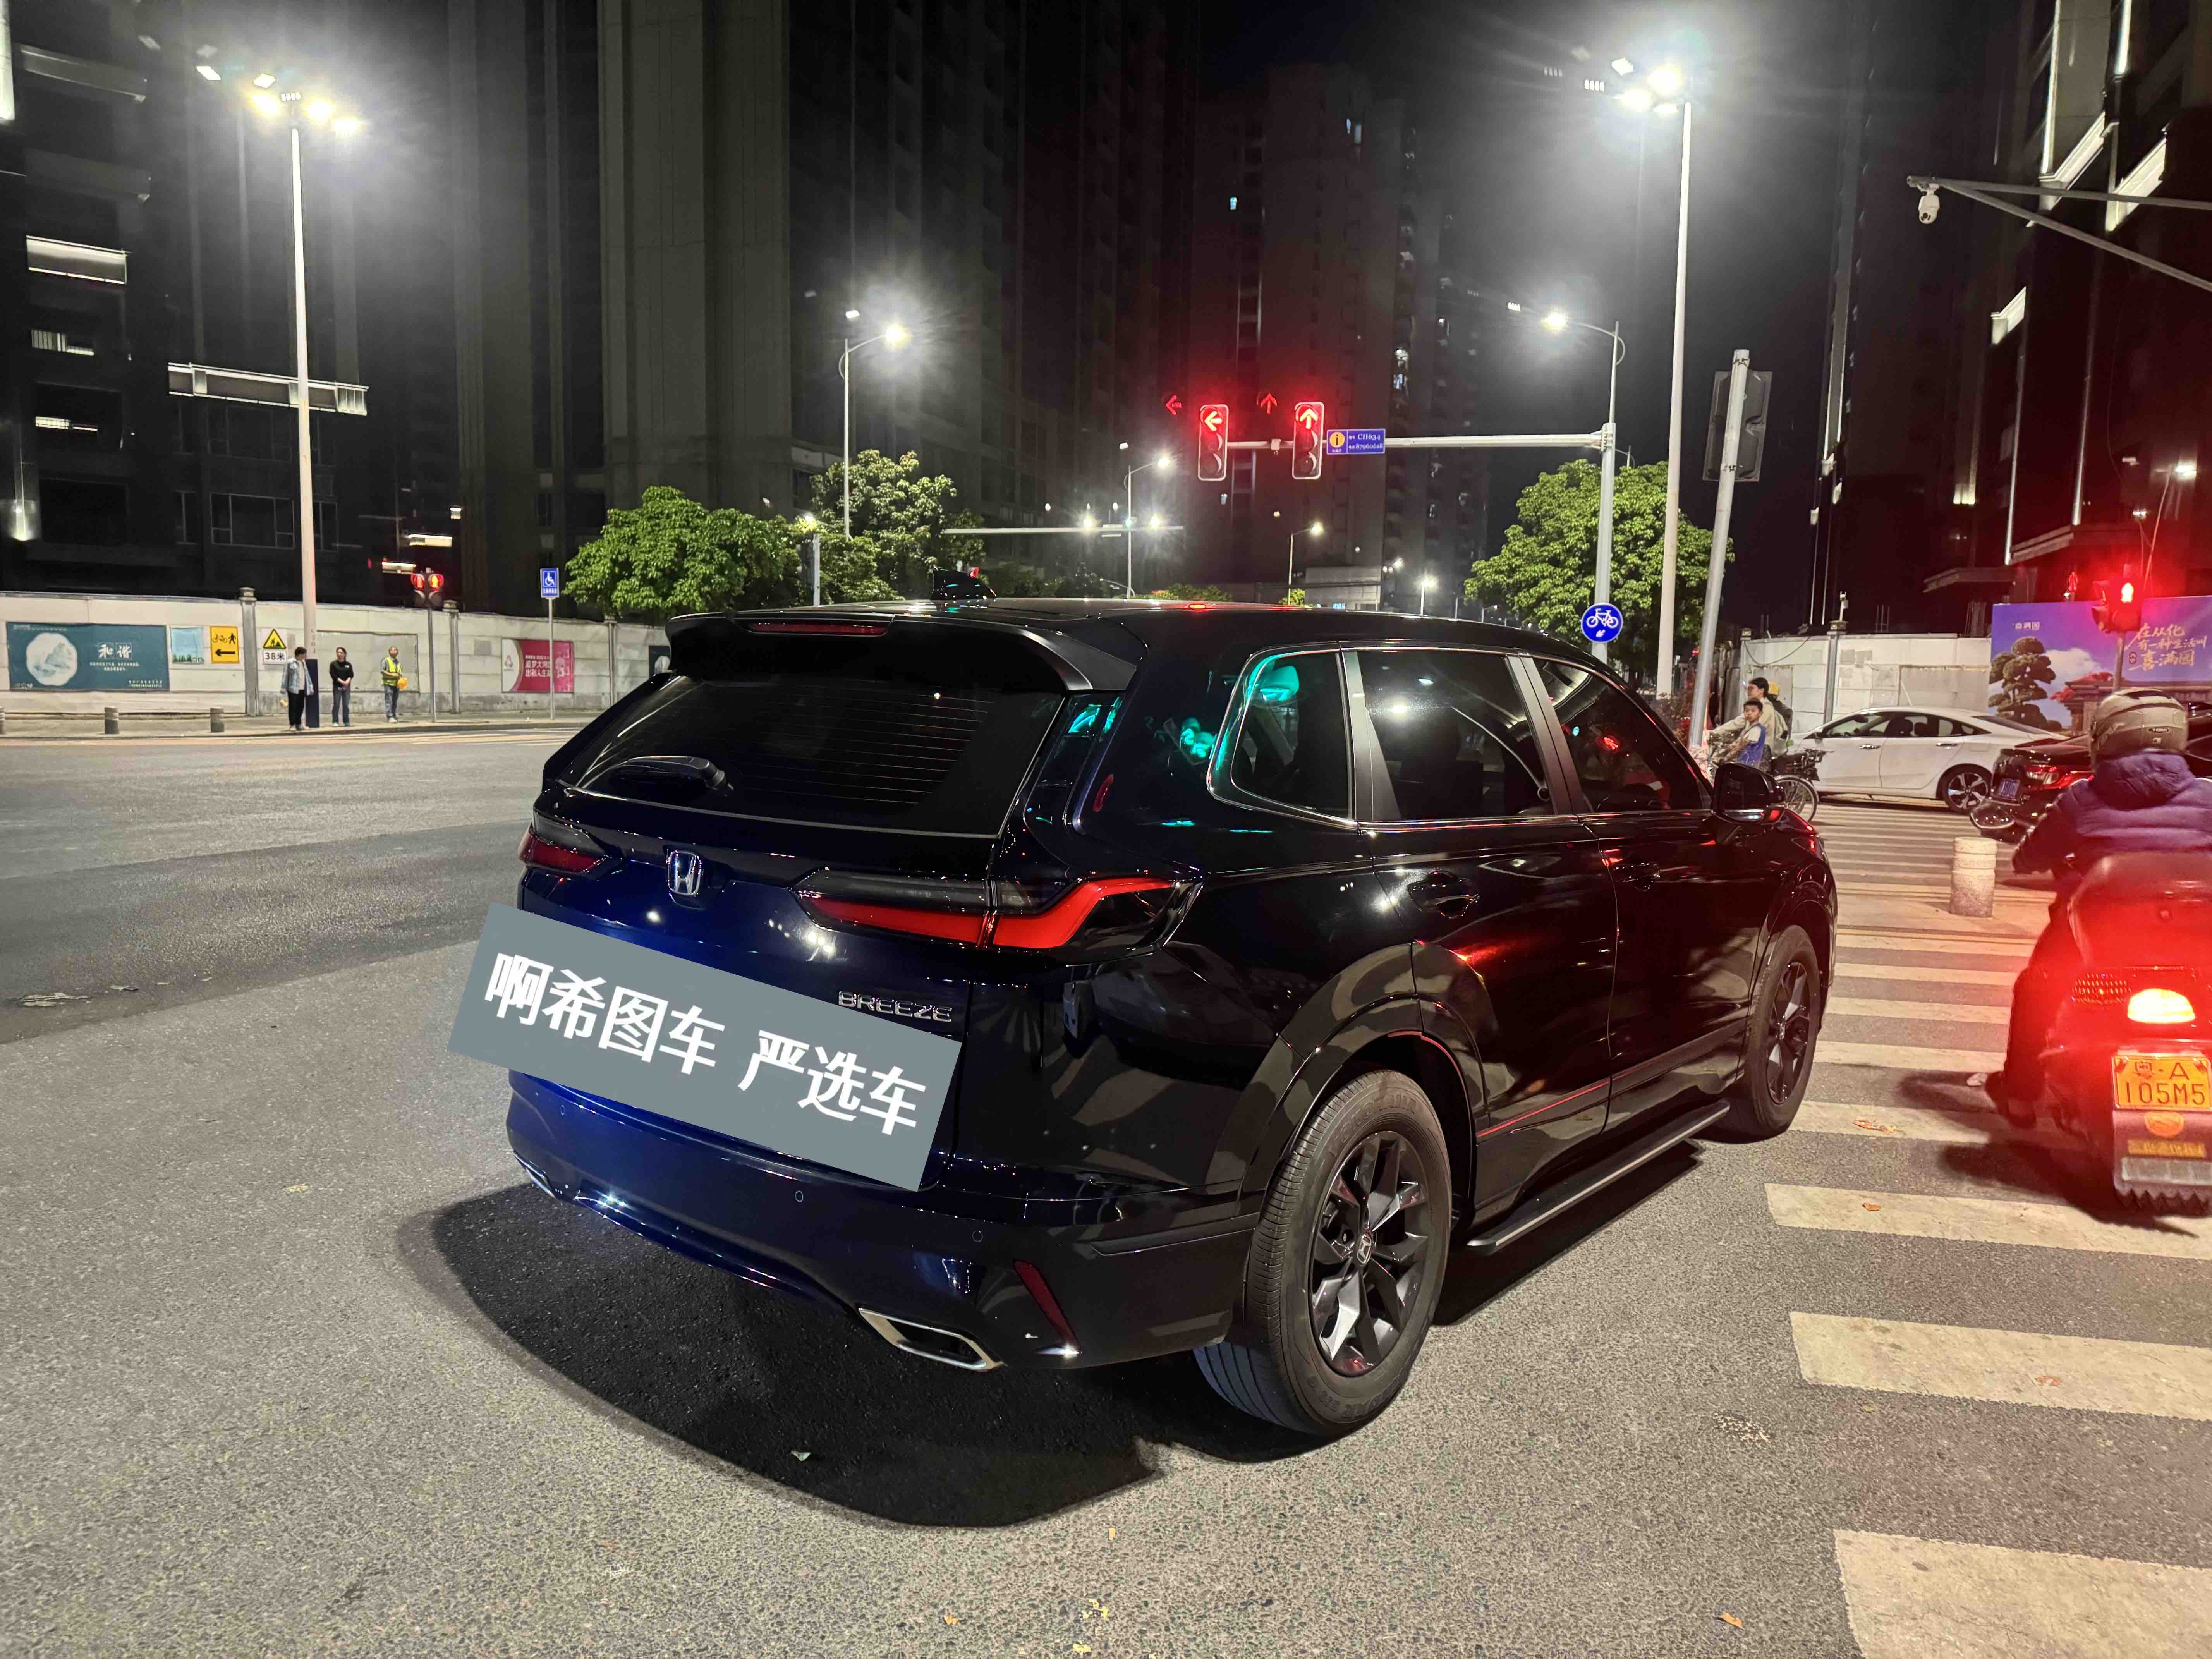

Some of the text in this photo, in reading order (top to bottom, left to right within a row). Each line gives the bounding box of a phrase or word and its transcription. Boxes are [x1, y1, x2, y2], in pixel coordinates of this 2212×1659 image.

[98, 644, 132, 659] 和谐
[838, 991, 953, 1023] BREEZE
[2126, 1082, 2205, 1105] 105M5
